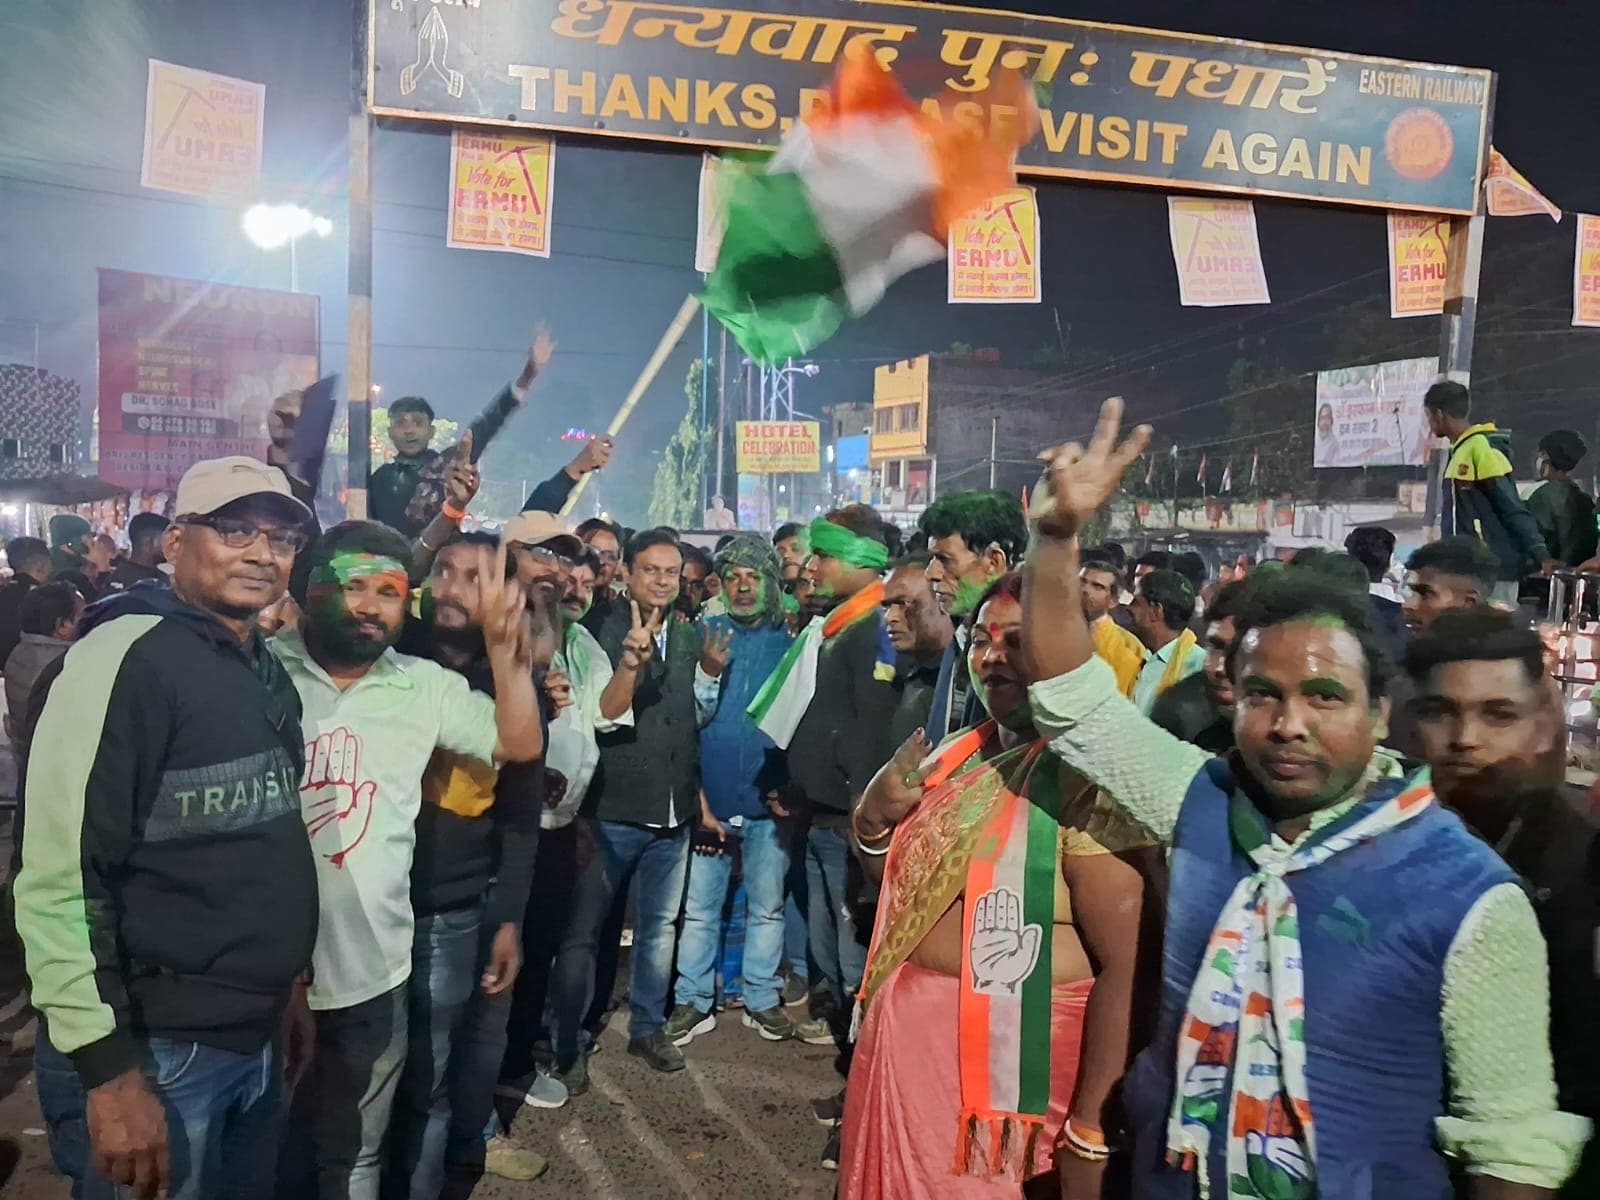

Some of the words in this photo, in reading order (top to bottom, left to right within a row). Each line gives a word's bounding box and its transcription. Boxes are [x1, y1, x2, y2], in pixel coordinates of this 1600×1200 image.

[551, 0, 917, 71] धन्यवाद
[1129, 50, 1337, 114] पधारें
[1359, 69, 1420, 99] EASTERN
[1424, 77, 1483, 104] RAILWAY
[461, 138, 502, 153] ERMU
[799, 87, 1017, 143] PASE
[1039, 109, 1187, 165] VISIT
[1202, 128, 1371, 186] AGAIN
[468, 166, 492, 184] Vote
[494, 170, 516, 189] for
[456, 187, 528, 214] ERMU
[955, 247, 1018, 268] ERMU
[1397, 262, 1447, 283] ERMU
[743, 424, 813, 438] HOTEL
[1371, 418, 1379, 433] 2
[168, 439, 201, 450] MAIN
[742, 440, 816, 456] CELEBRATION
